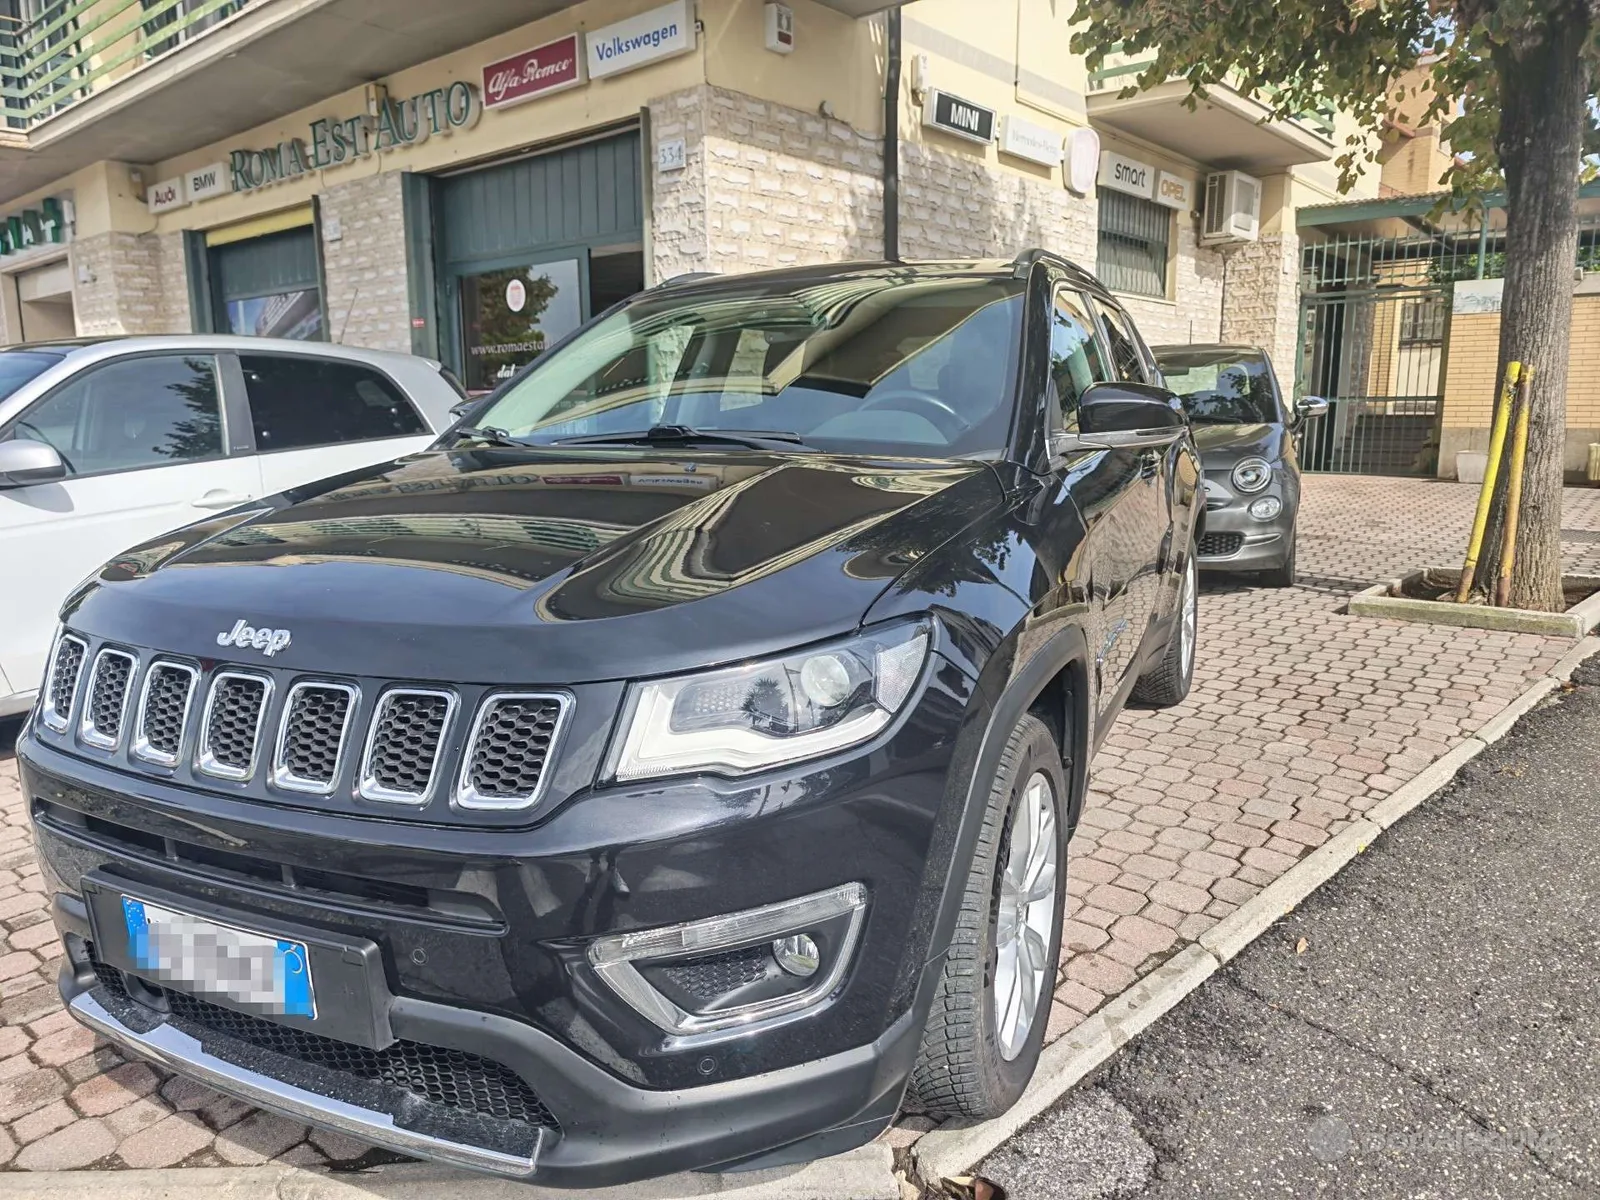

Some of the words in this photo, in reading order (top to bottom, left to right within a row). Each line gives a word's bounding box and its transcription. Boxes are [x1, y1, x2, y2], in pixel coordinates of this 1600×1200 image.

[595, 23, 678, 61] Volkswagen
[488, 68, 519, 101] Alfa
[521, 58, 570, 85] Romeo
[950, 103, 980, 133] MINI
[229, 138, 304, 193] ROMA
[309, 116, 361, 169] EST
[374, 80, 471, 151] AUTO
[193, 171, 216, 191] BMW
[1114, 162, 1146, 188] smart
[154, 187, 176, 206] Audi
[1161, 179, 1186, 202] OPEL
[497, 364, 516, 378] dal
[216, 619, 292, 658] Jeep
